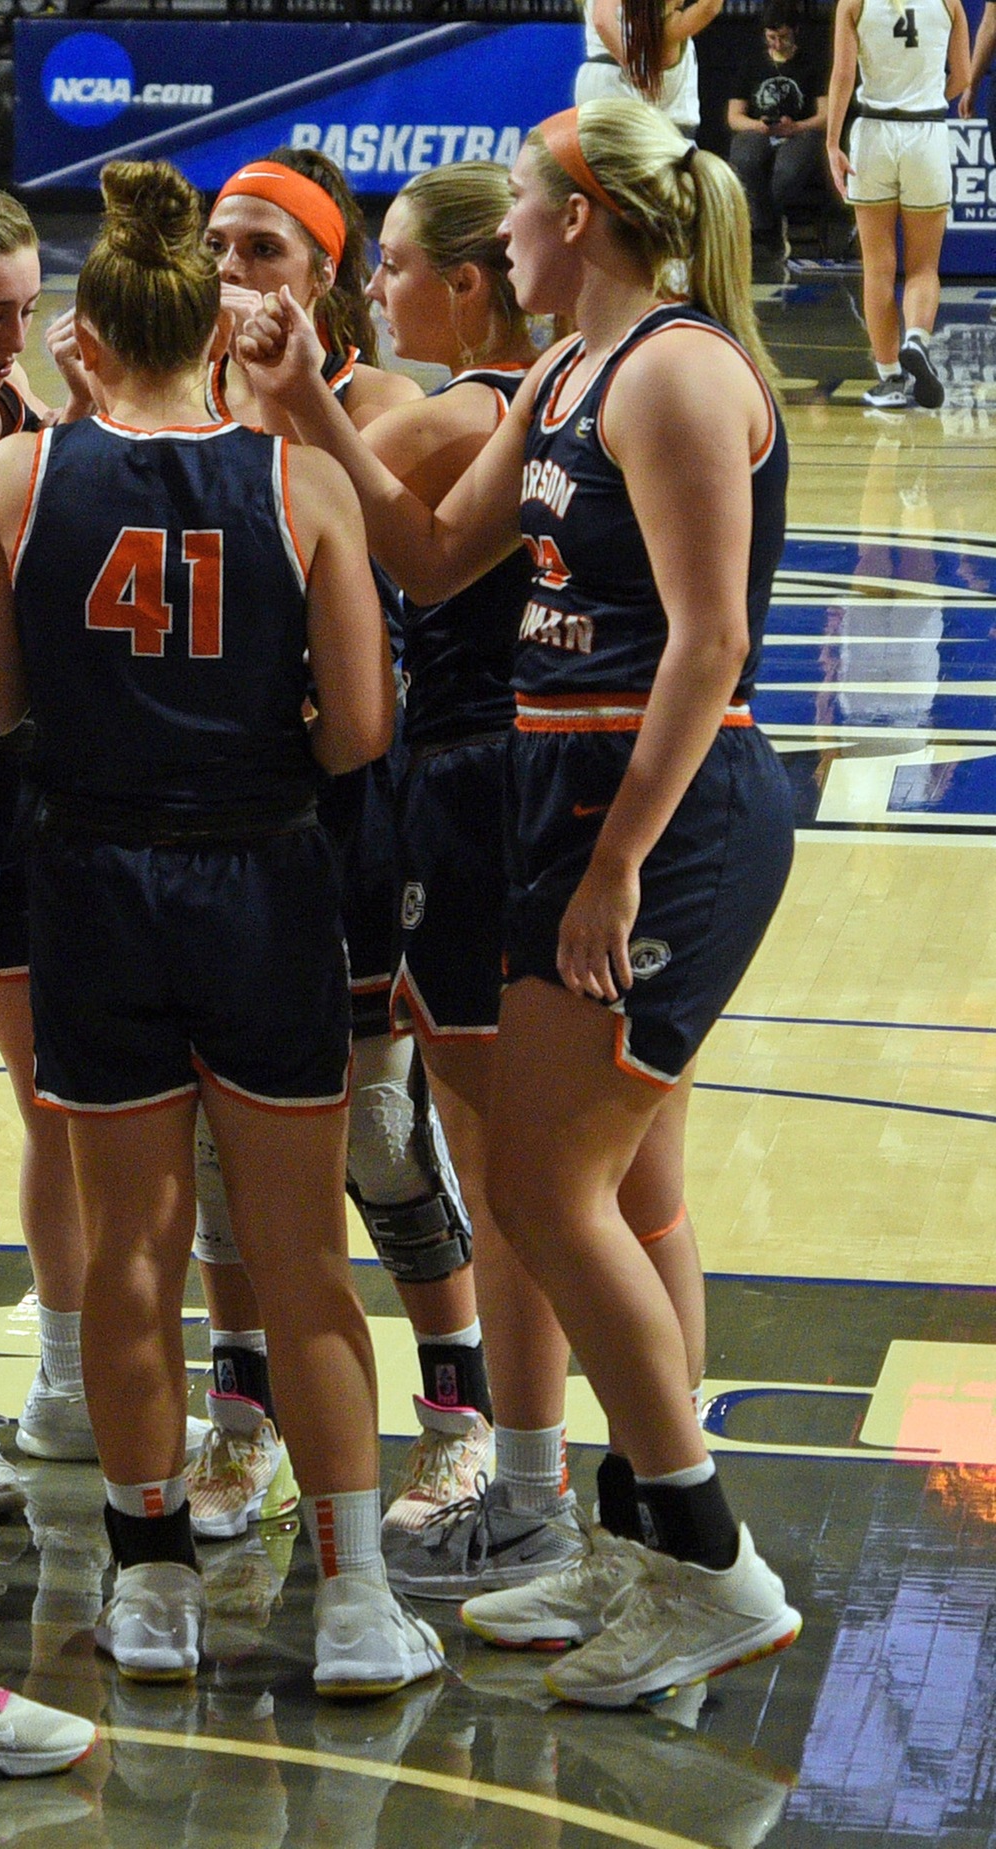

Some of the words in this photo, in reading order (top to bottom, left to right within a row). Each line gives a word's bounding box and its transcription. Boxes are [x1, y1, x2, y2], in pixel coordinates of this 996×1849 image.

[893, 9, 918, 48] 4
[50, 77, 213, 105] NCAA.com
[85, 526, 224, 658] 41
